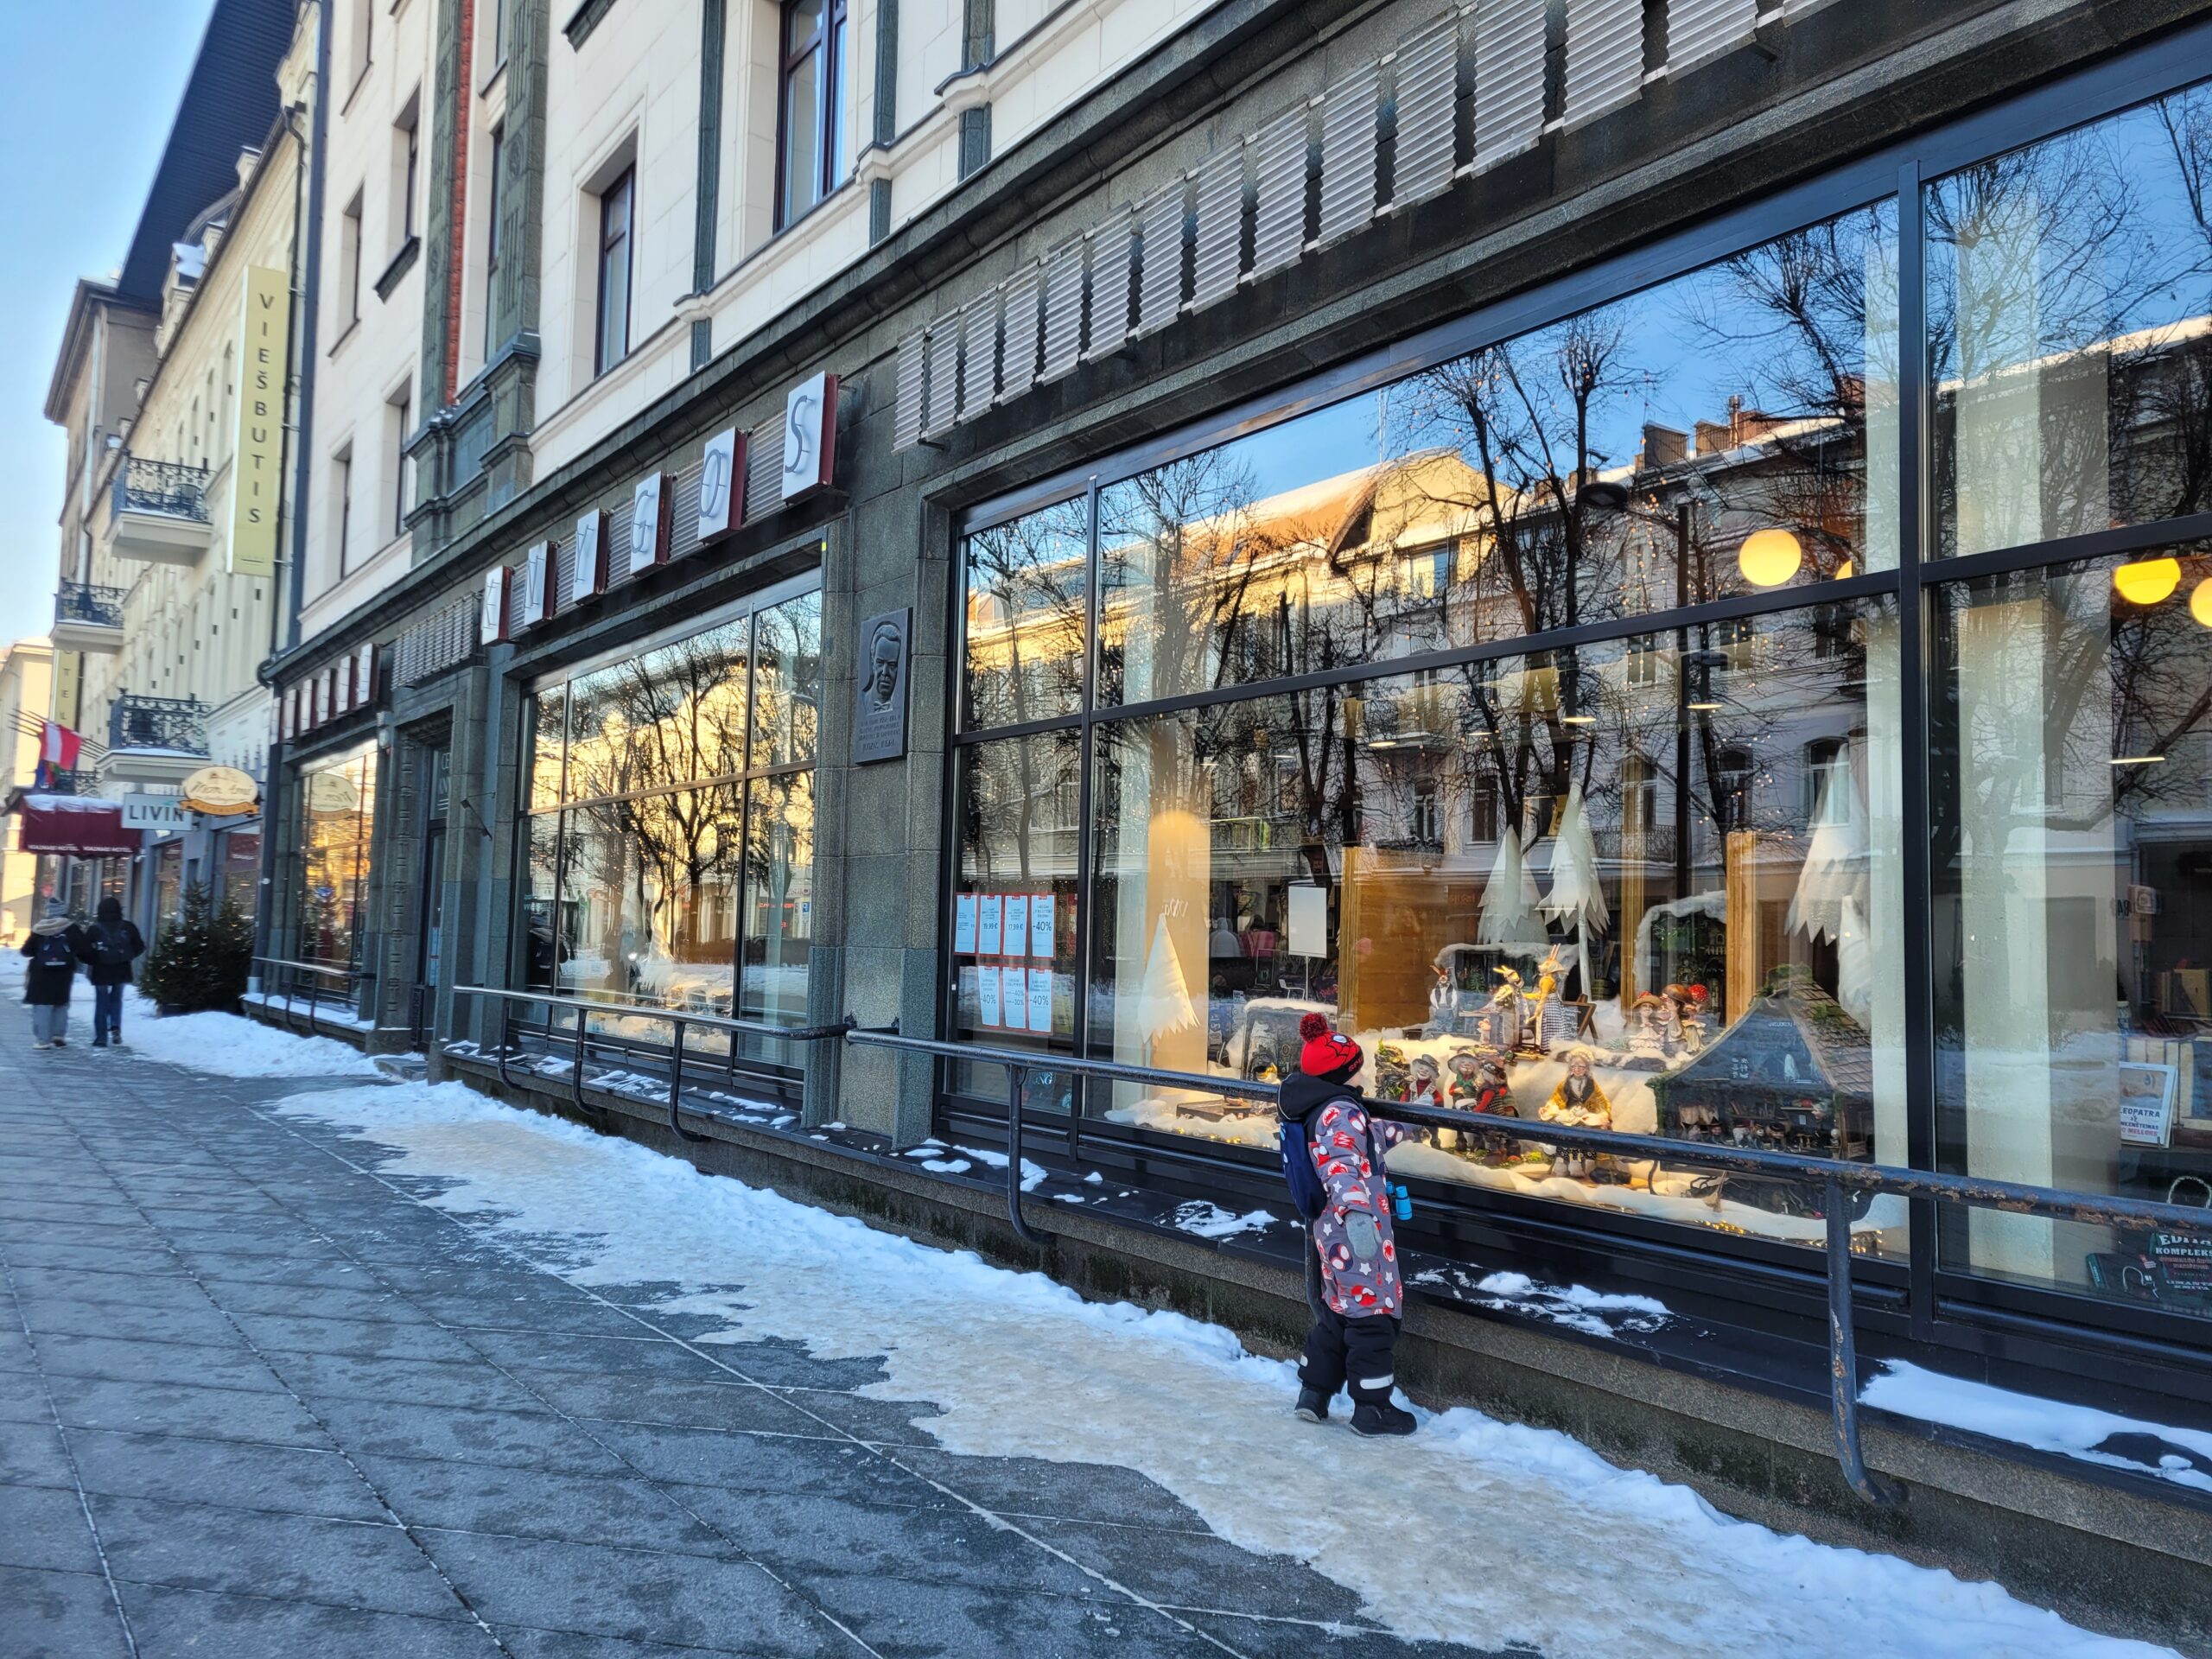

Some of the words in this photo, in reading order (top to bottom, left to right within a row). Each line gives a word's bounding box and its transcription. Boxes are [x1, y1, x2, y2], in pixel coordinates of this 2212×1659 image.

[248, 292, 276, 524] VIEŠBUTIS
[485, 394, 814, 631] KNYGOS
[1033, 921, 1052, 931] -40%
[1030, 995, 1049, 1006] -40%
[2120, 1107, 2160, 1118] EOPATRA
